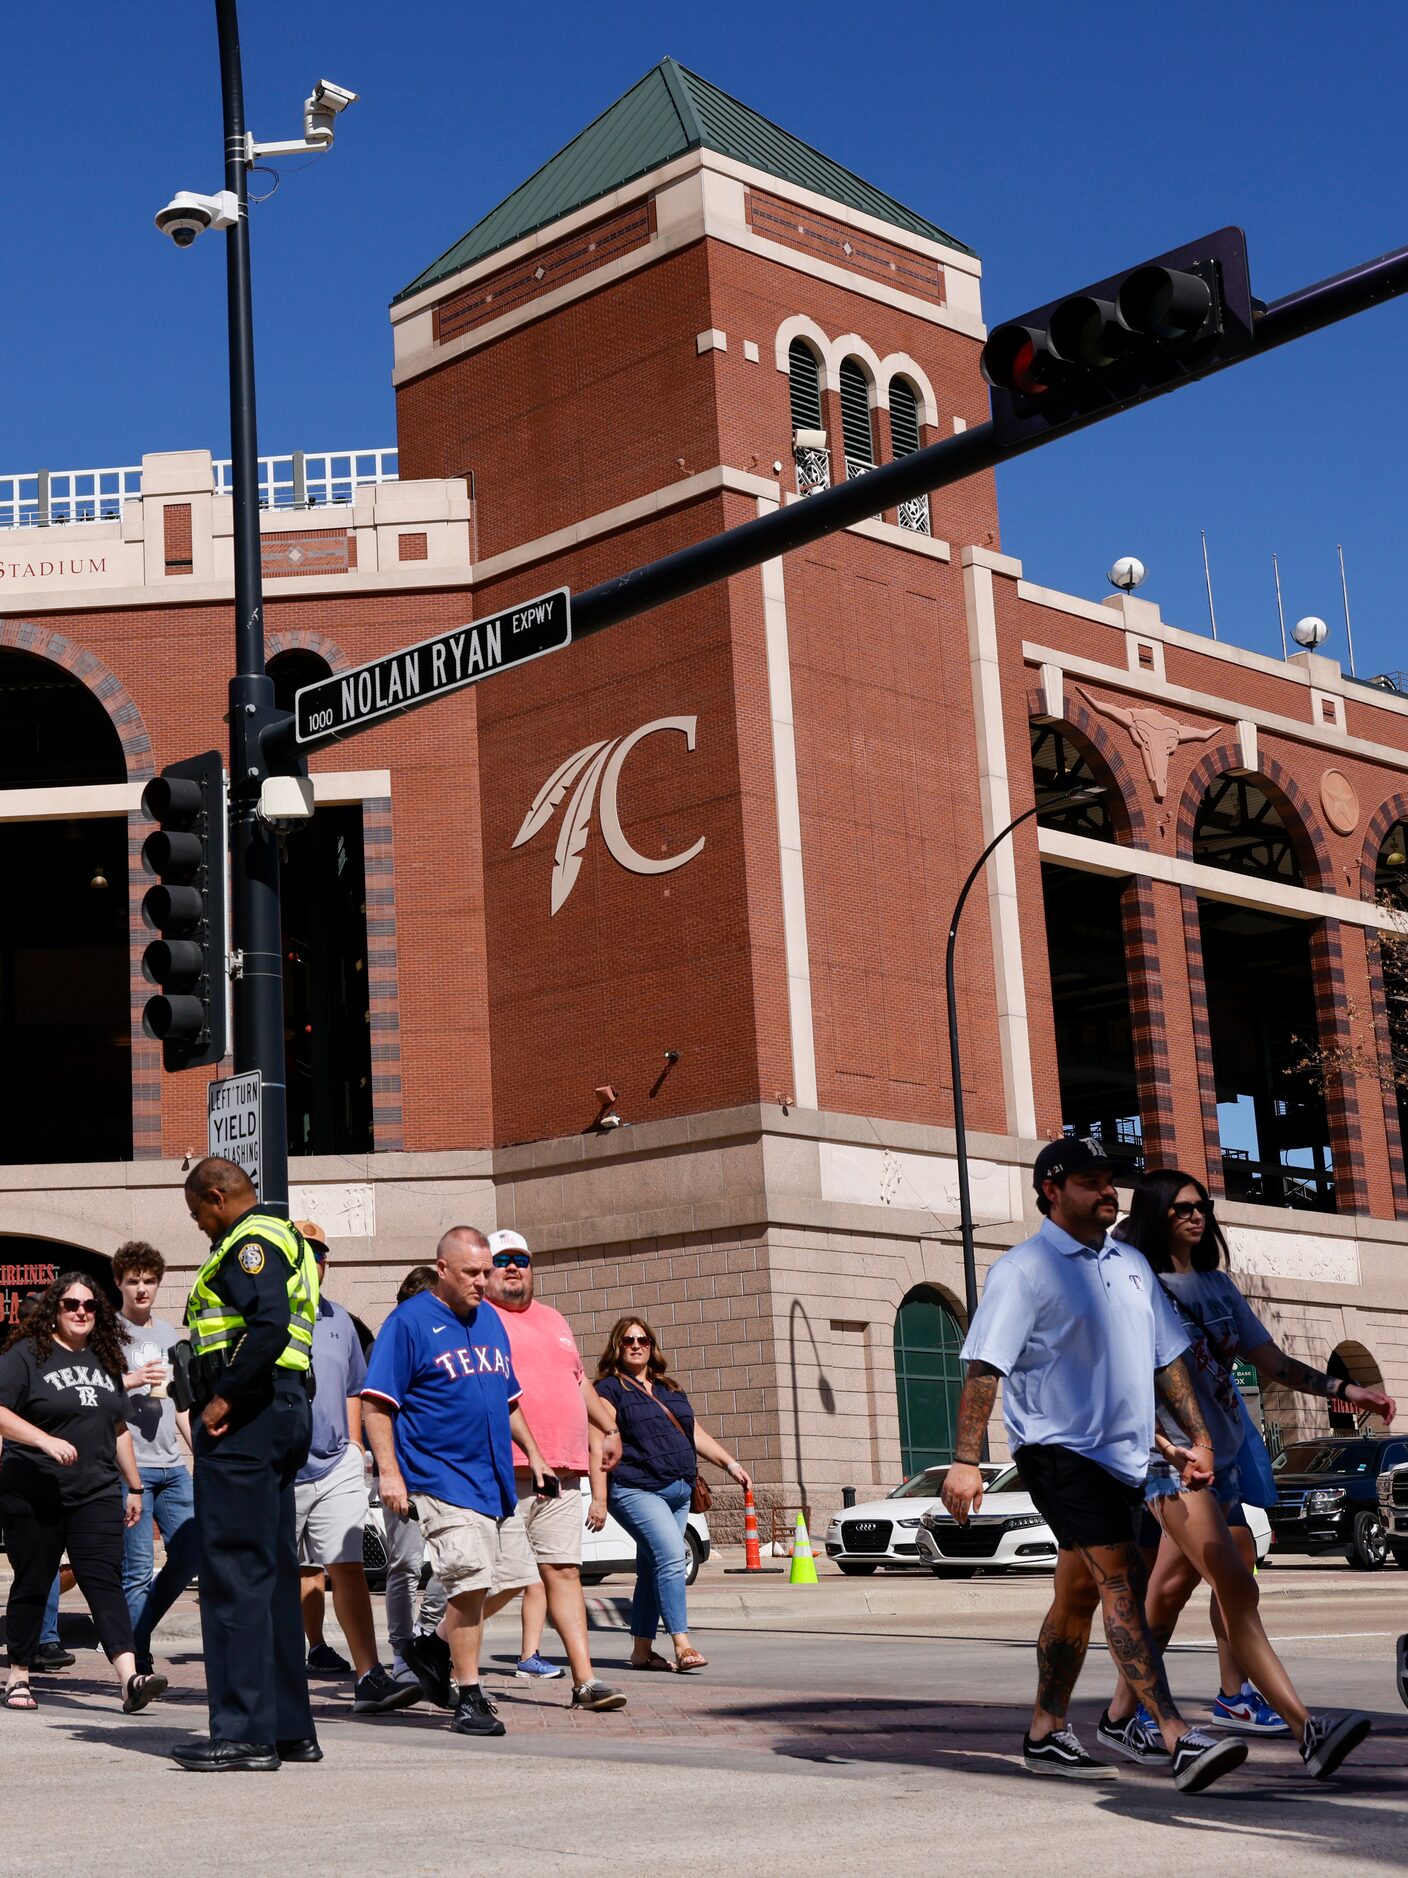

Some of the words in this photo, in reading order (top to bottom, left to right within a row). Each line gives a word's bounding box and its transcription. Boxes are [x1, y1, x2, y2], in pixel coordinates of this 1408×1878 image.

[308, 708, 334, 732] 1000
[342, 652, 421, 720] NOLAN
[433, 621, 502, 687] RYAN
[512, 601, 554, 634] EXPWY
[210, 1088, 231, 1112] LEFT
[236, 1081, 258, 1106] TURN
[213, 1111, 257, 1143] YIELD
[42, 1365, 115, 1393] TEXAS
[433, 1345, 511, 1382] TEXAS
